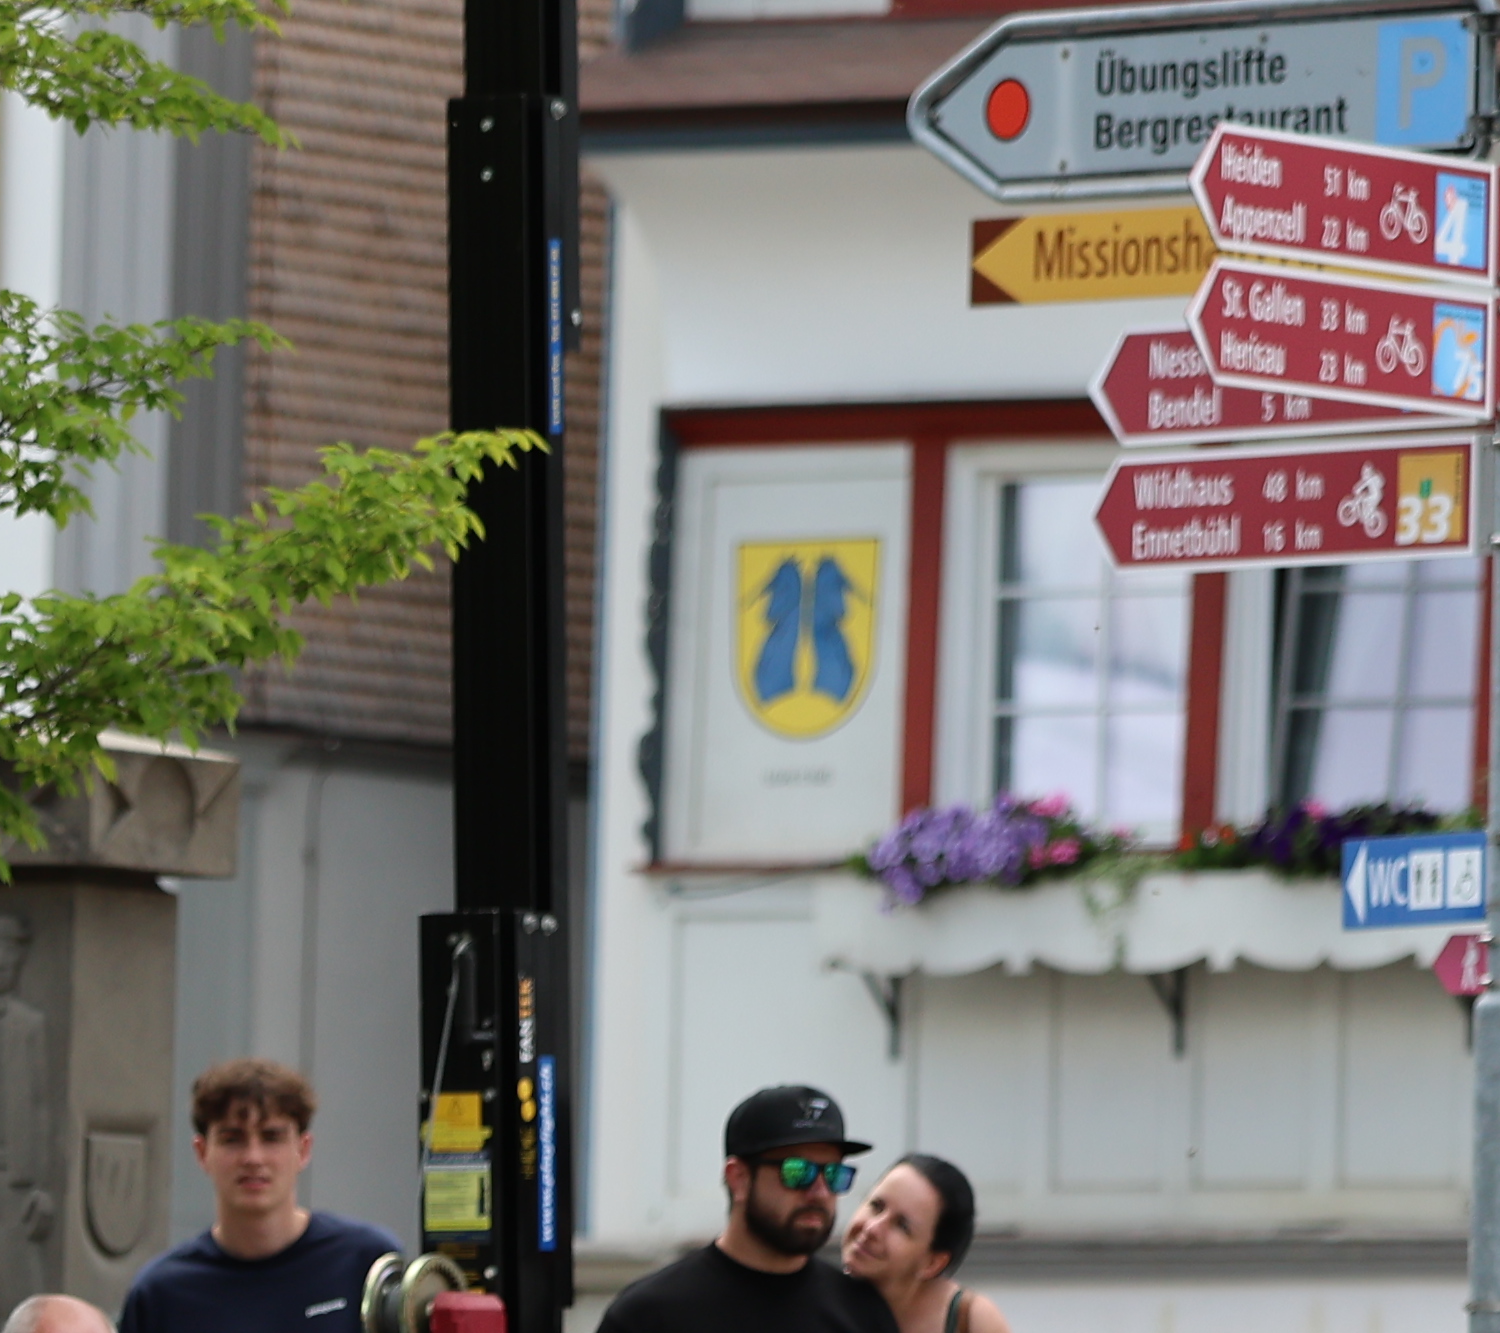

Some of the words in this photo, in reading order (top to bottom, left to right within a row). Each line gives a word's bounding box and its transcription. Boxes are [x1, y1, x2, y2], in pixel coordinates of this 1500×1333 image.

[1095, 46, 1287, 98] Übungslifte
[1399, 37, 1446, 130] P
[1220, 142, 1282, 188] Heiden
[1346, 165, 1370, 202] km
[1033, 218, 1203, 281] Missionsh
[1220, 196, 1307, 246] Appenzell
[1346, 217, 1370, 254] km
[1435, 198, 1469, 265] 4
[1221, 277, 1246, 319] St.
[1249, 282, 1306, 327] Gallen
[1345, 298, 1368, 336] km
[1220, 328, 1287, 375] Herisau
[1344, 352, 1367, 387] km
[1148, 384, 1222, 429] Bendel
[1283, 392, 1311, 421] km
[1133, 470, 1234, 511] Wildhaus
[1295, 466, 1325, 501] km
[1131, 516, 1240, 560] Ennetbühl
[1295, 516, 1323, 550] km
[1396, 495, 1454, 544] 33
[1367, 852, 1408, 907] WC
